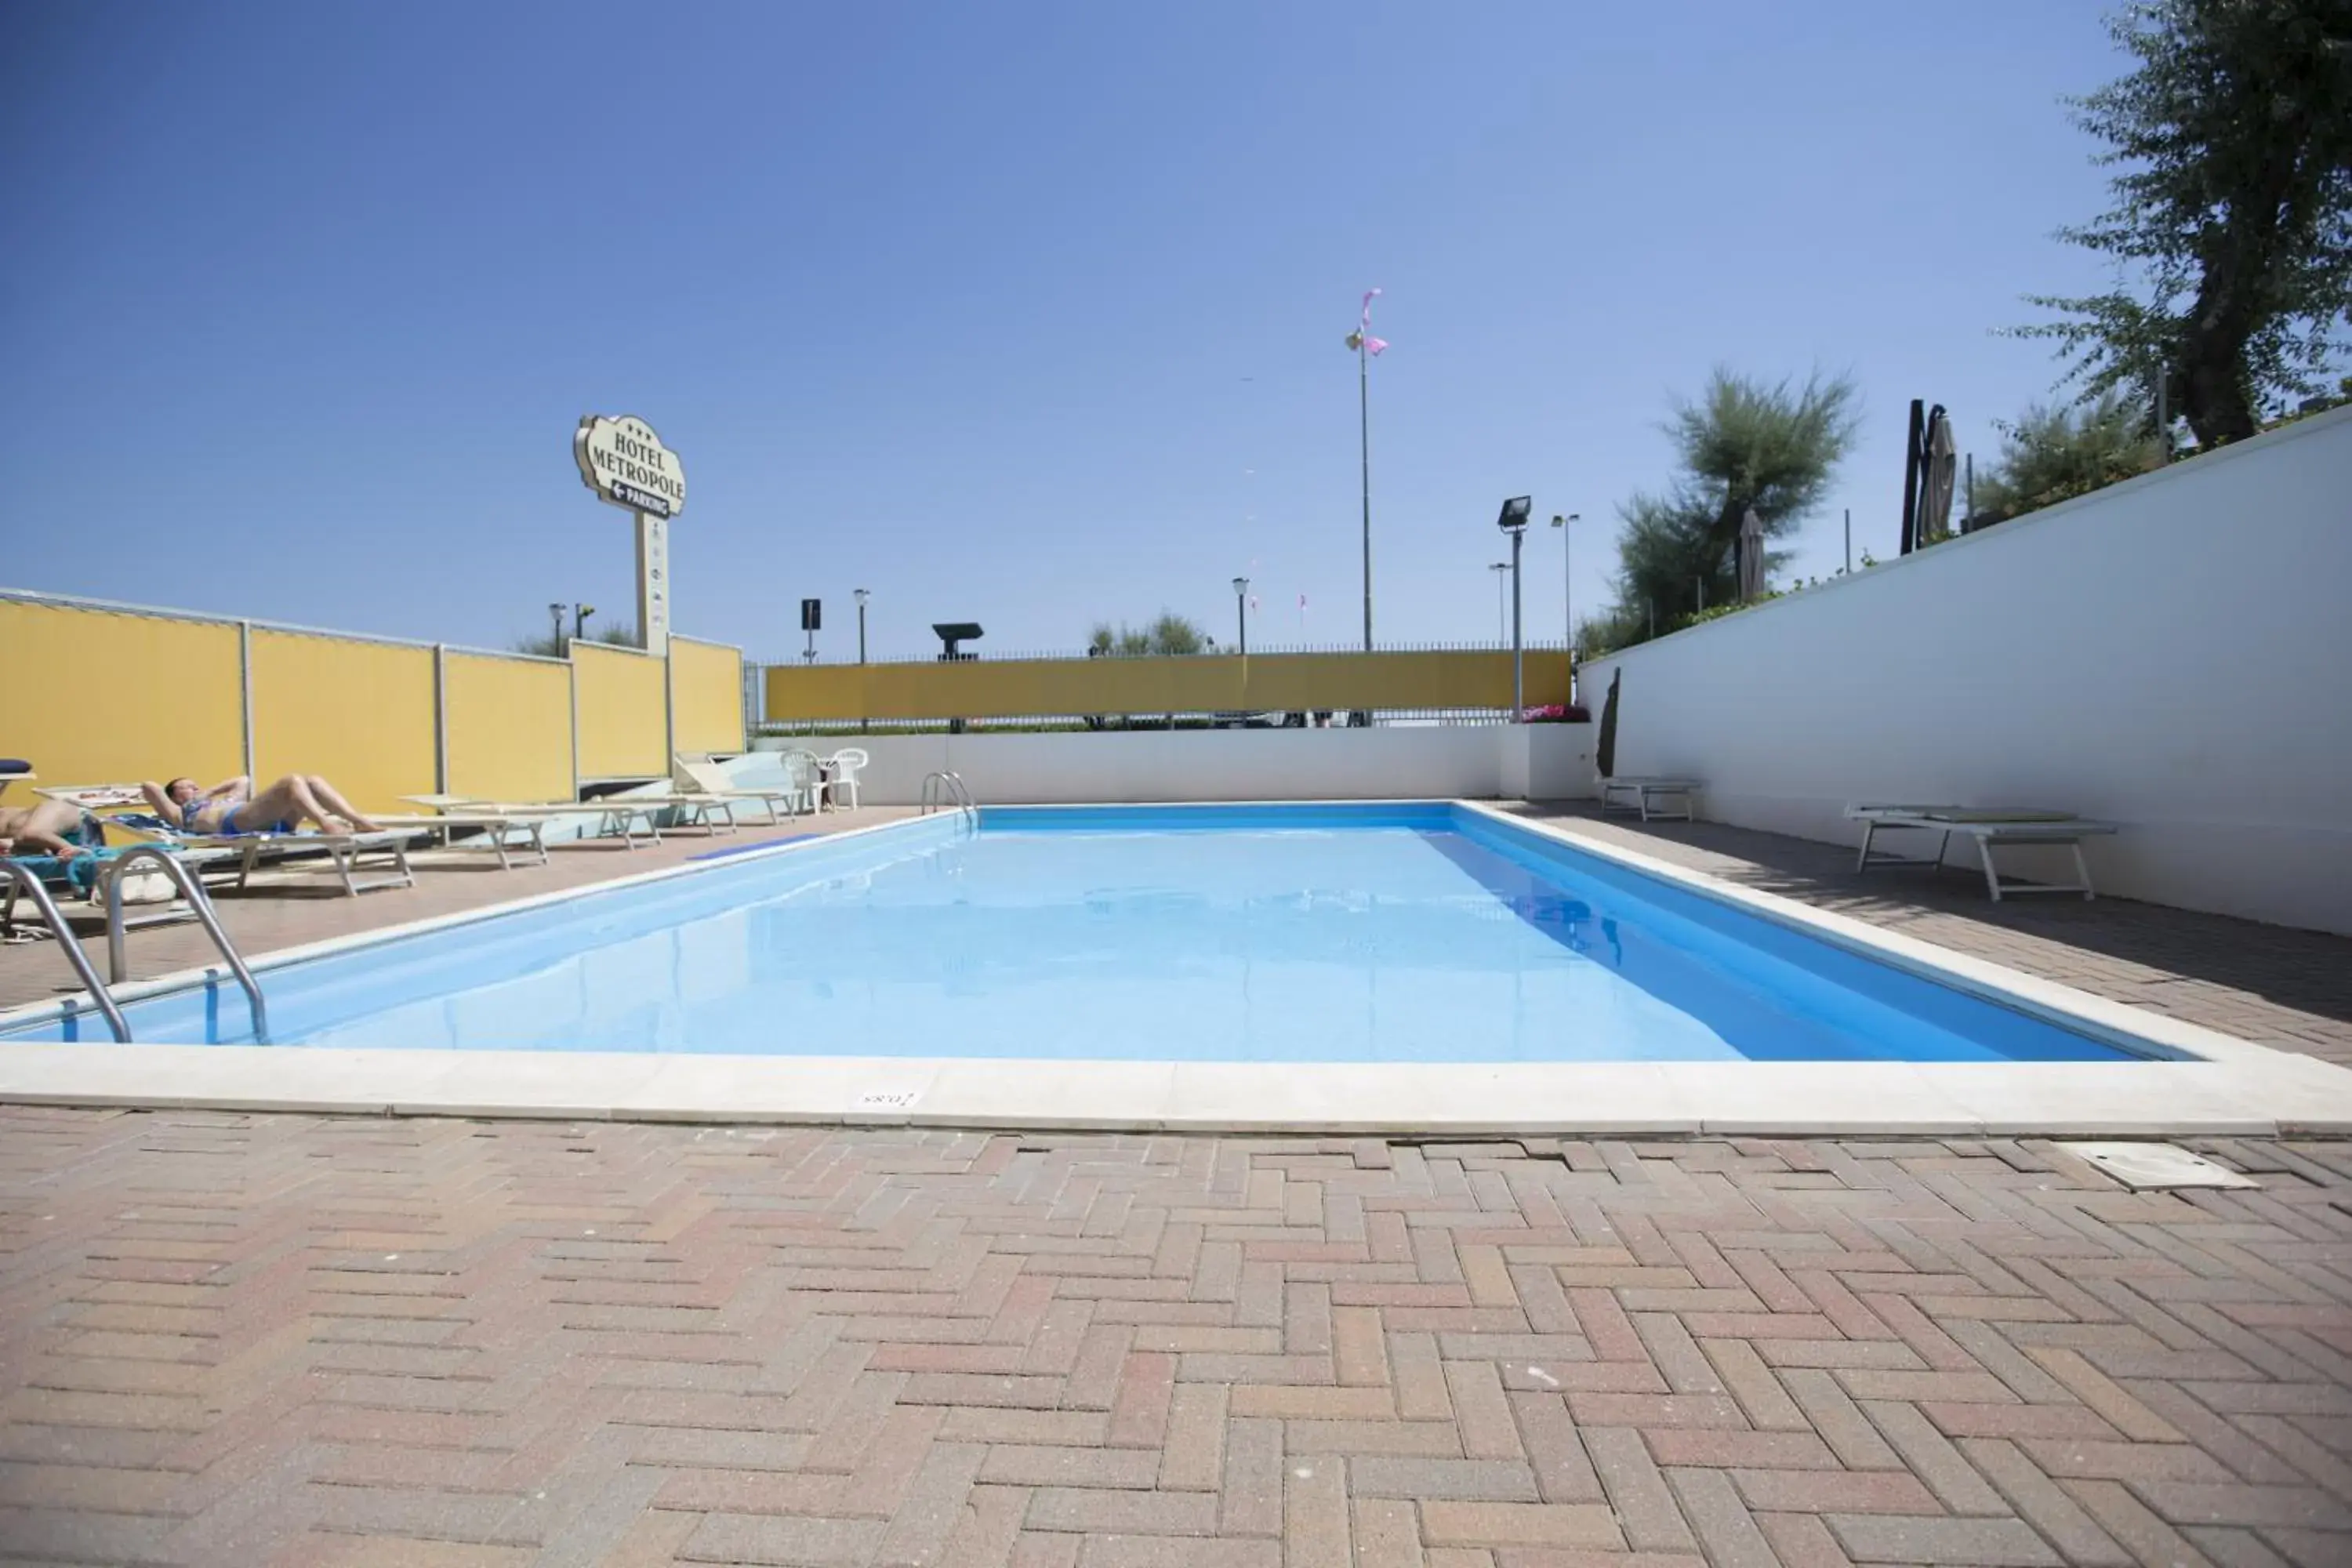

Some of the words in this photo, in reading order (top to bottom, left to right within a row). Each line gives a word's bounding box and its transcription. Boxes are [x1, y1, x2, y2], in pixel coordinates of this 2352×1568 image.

[615, 432, 665, 472] HOTEL
[593, 446, 684, 499] METROPOLE
[626, 488, 667, 515] PARKING
